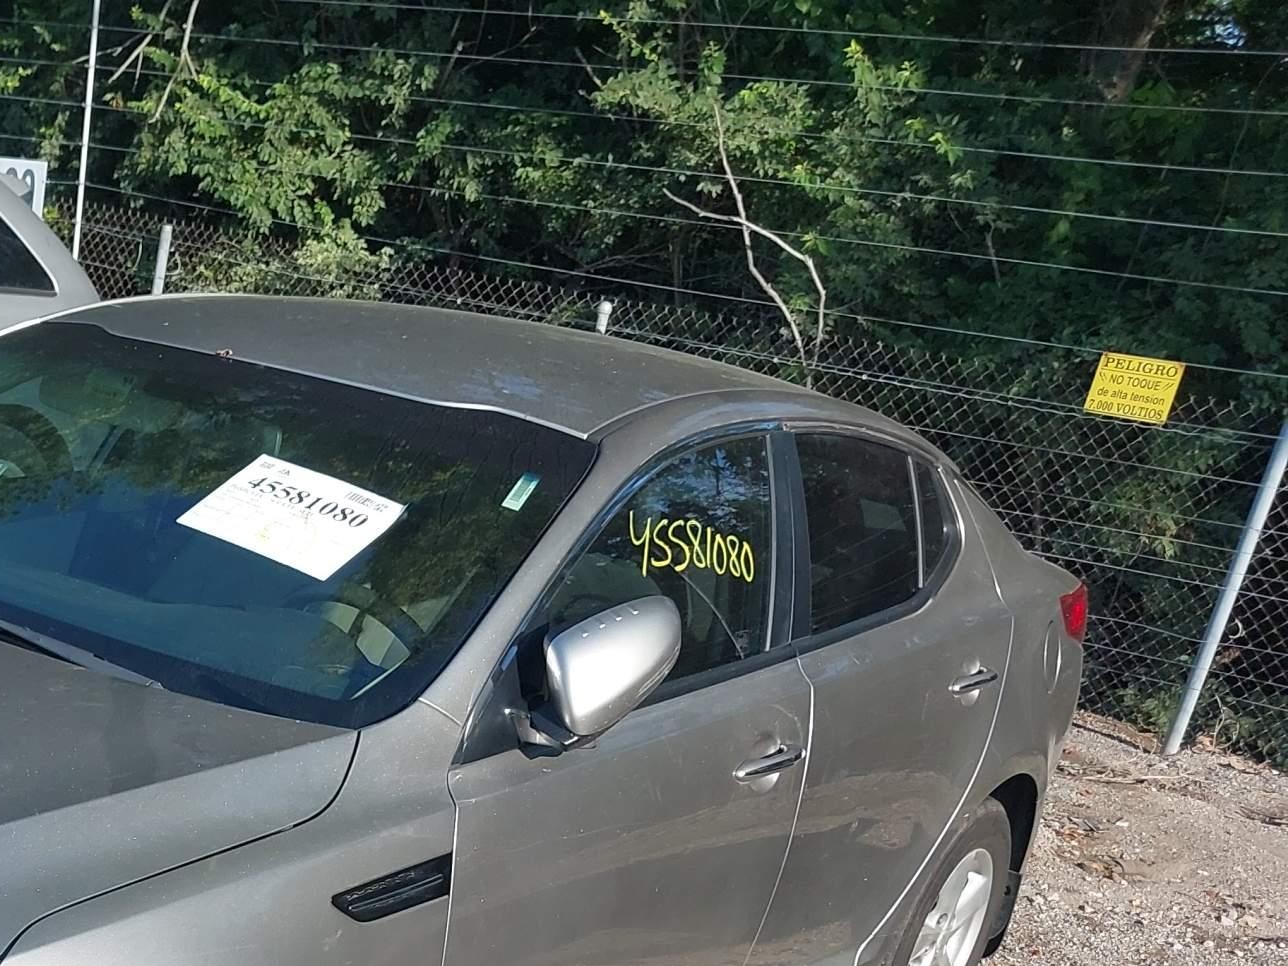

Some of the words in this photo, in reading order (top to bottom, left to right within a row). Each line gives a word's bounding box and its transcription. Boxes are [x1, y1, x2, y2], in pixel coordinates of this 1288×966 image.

[1103, 356, 1178, 378] PELIGRO
[1109, 374, 1124, 385] NO
[1127, 376, 1162, 391] TOQUE
[1097, 386, 1109, 397] de
[1111, 389, 1128, 400] alta
[1130, 392, 1165, 406] tension
[1088, 398, 1113, 412] 7.000
[1116, 402, 1163, 420] VOLTIOS
[247, 477, 369, 528] 45581080
[629, 509, 755, 583] 45581080
